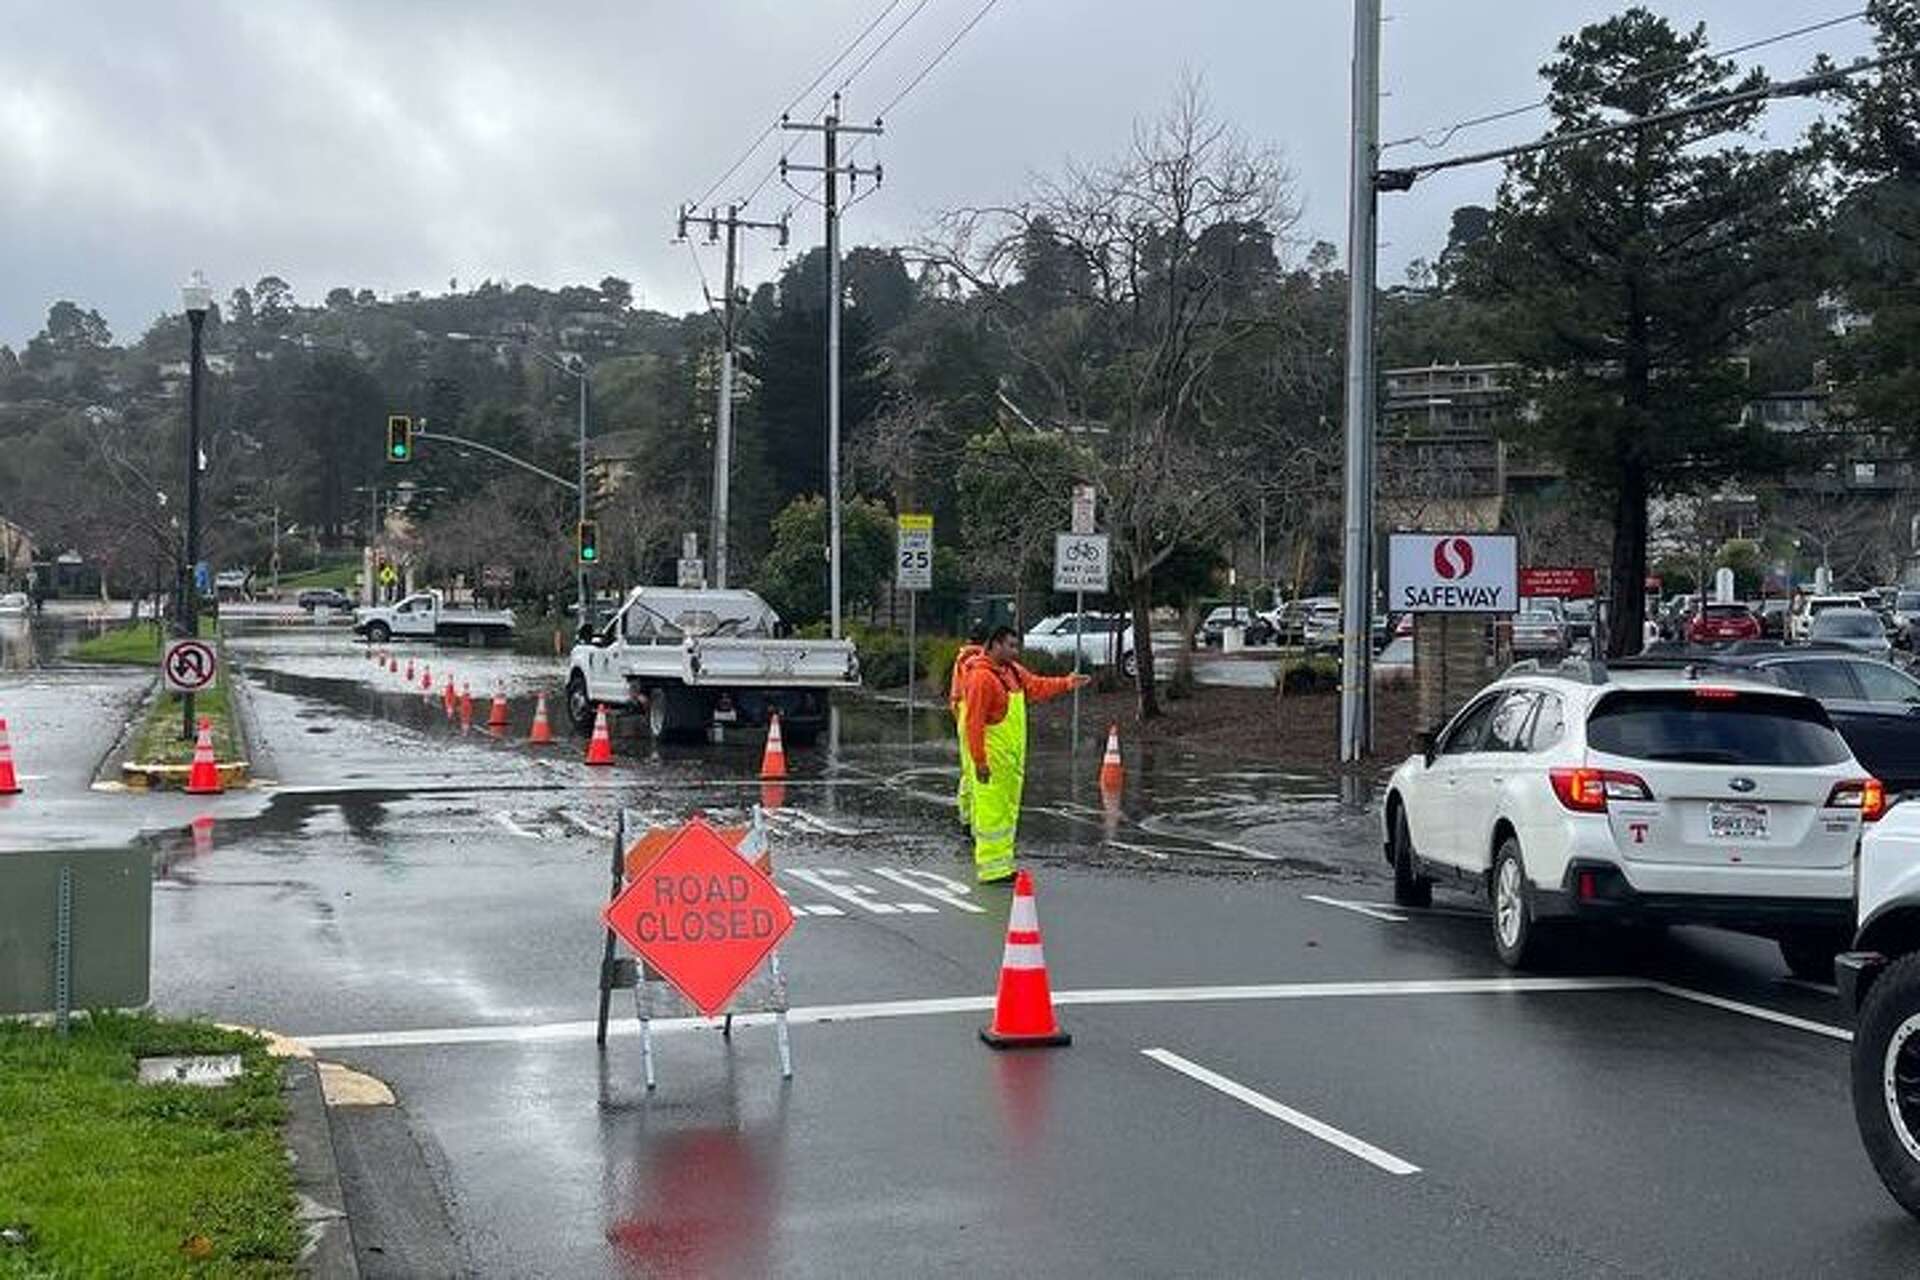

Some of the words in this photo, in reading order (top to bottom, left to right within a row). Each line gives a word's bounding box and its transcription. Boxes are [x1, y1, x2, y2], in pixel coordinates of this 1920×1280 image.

[901, 551, 929, 569] 25
[1404, 586, 1502, 608] SAFEWAY
[1630, 824, 1648, 843] T
[654, 874, 749, 905] ROAD
[636, 909, 774, 943] CLOSED
